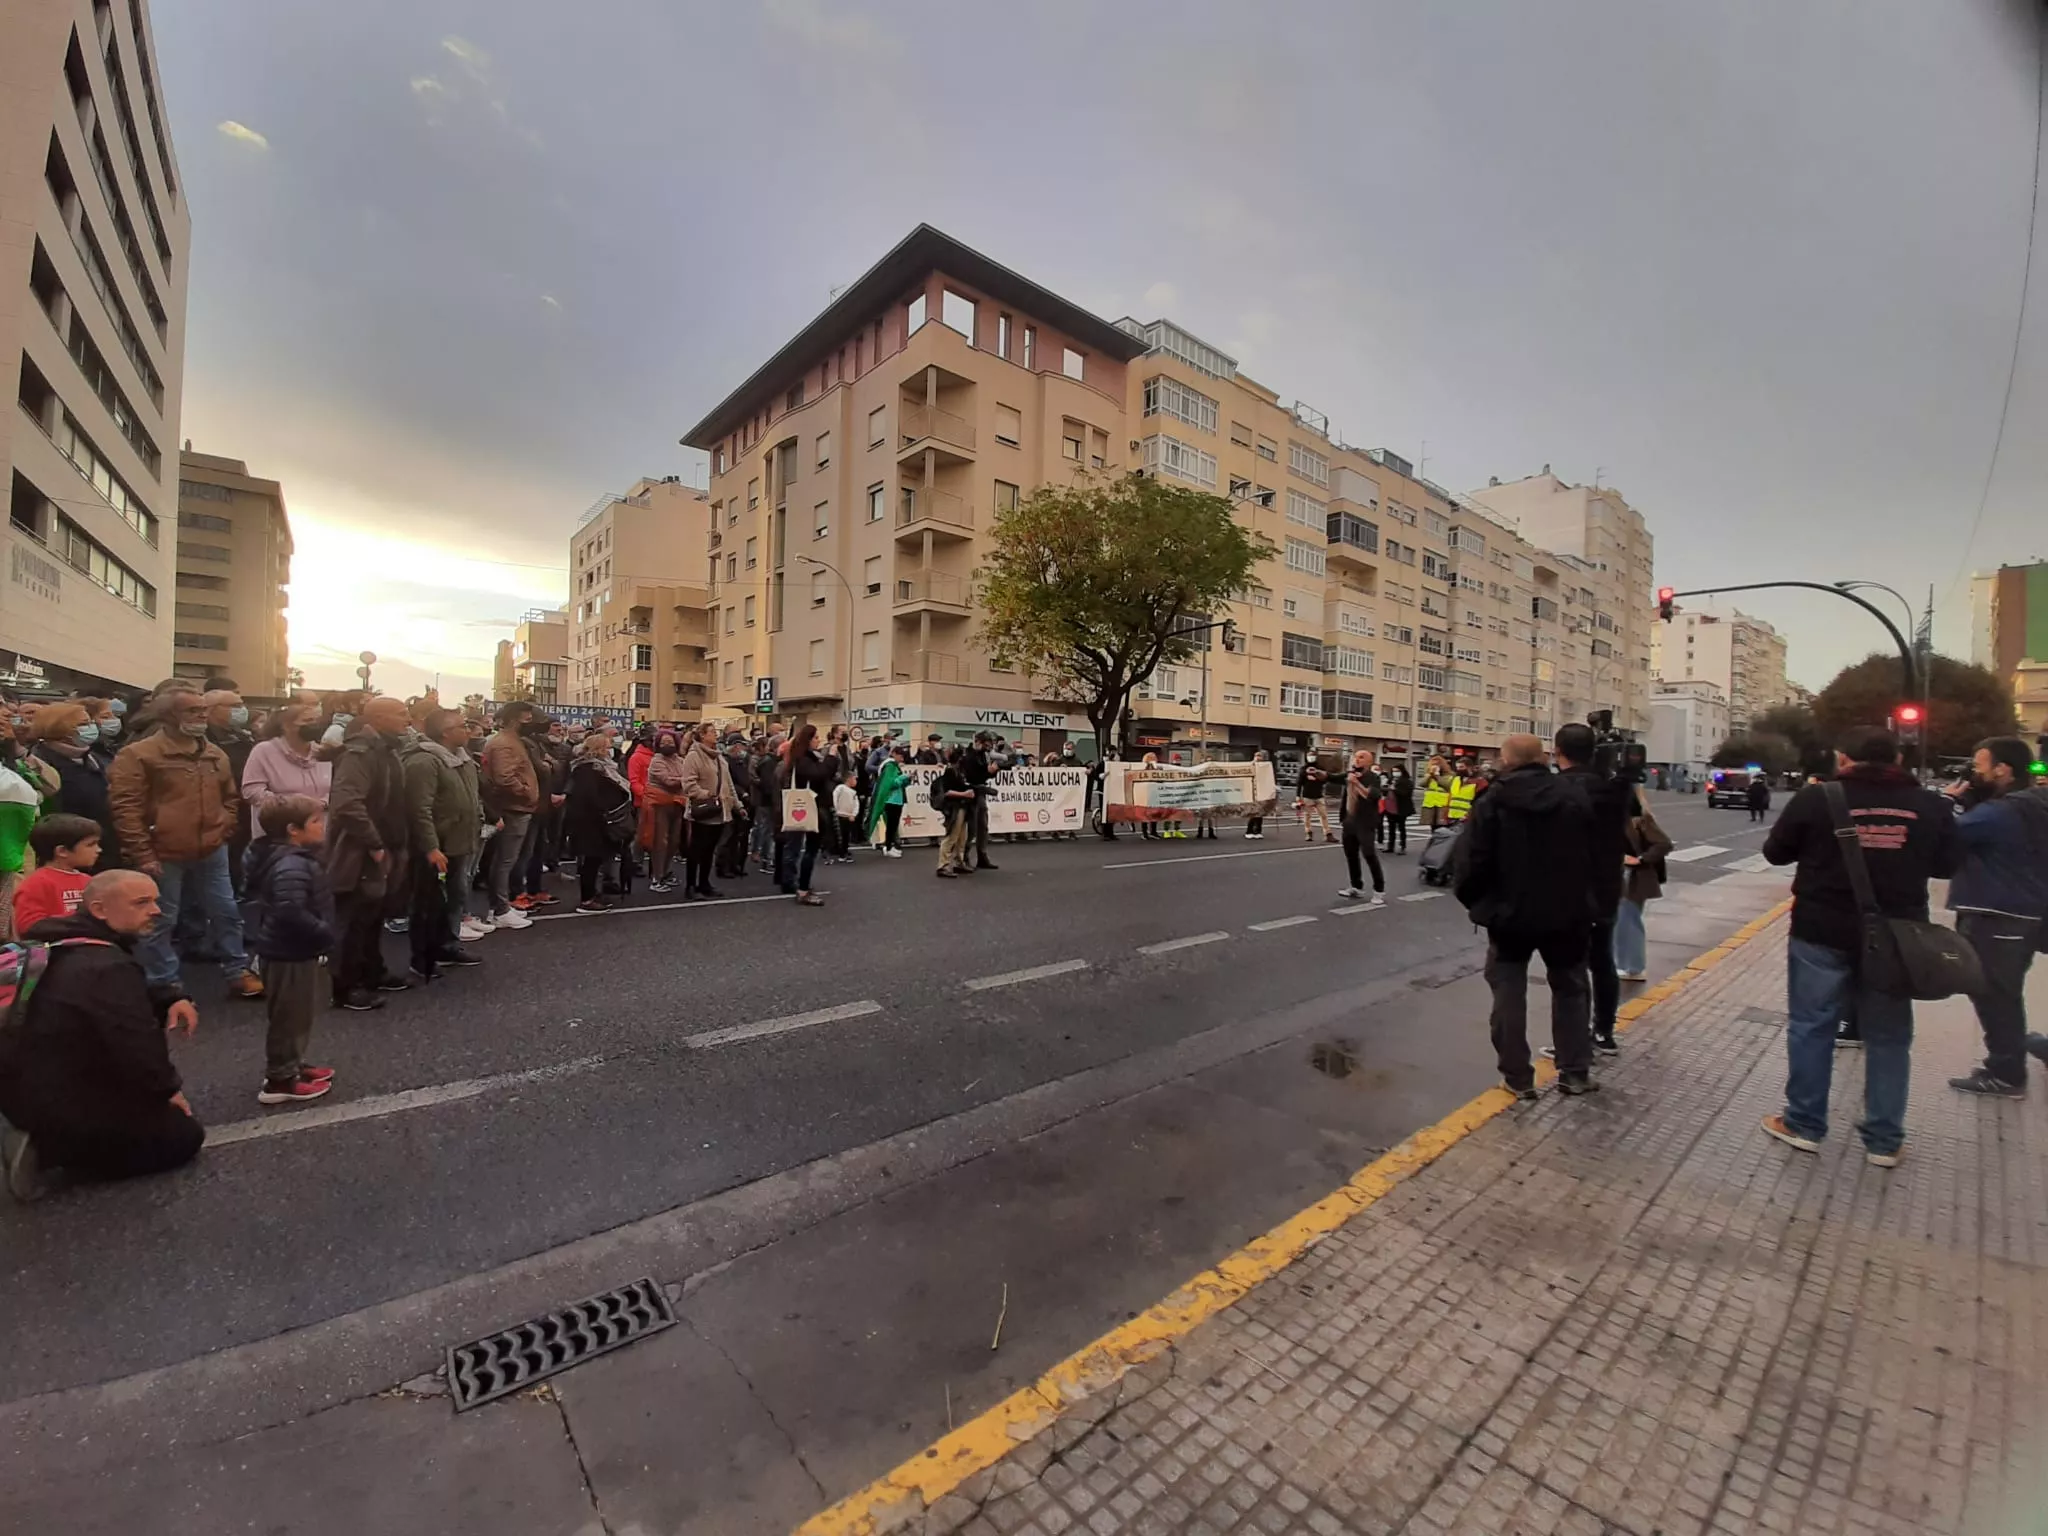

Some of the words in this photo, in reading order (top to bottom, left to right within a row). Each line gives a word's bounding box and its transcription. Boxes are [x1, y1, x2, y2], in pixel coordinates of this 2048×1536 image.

[581, 707, 595, 716] 24
[597, 708, 632, 718] ORAS
[572, 717, 623, 728] ENTDA
[975, 710, 1021, 725] VITAL
[1023, 714, 1065, 727] DENT
[994, 771, 1016, 787] UNA
[1018, 771, 1044, 786] SOLA
[1047, 771, 1081, 786] LUCHA
[1023, 792, 1031, 802] DE
